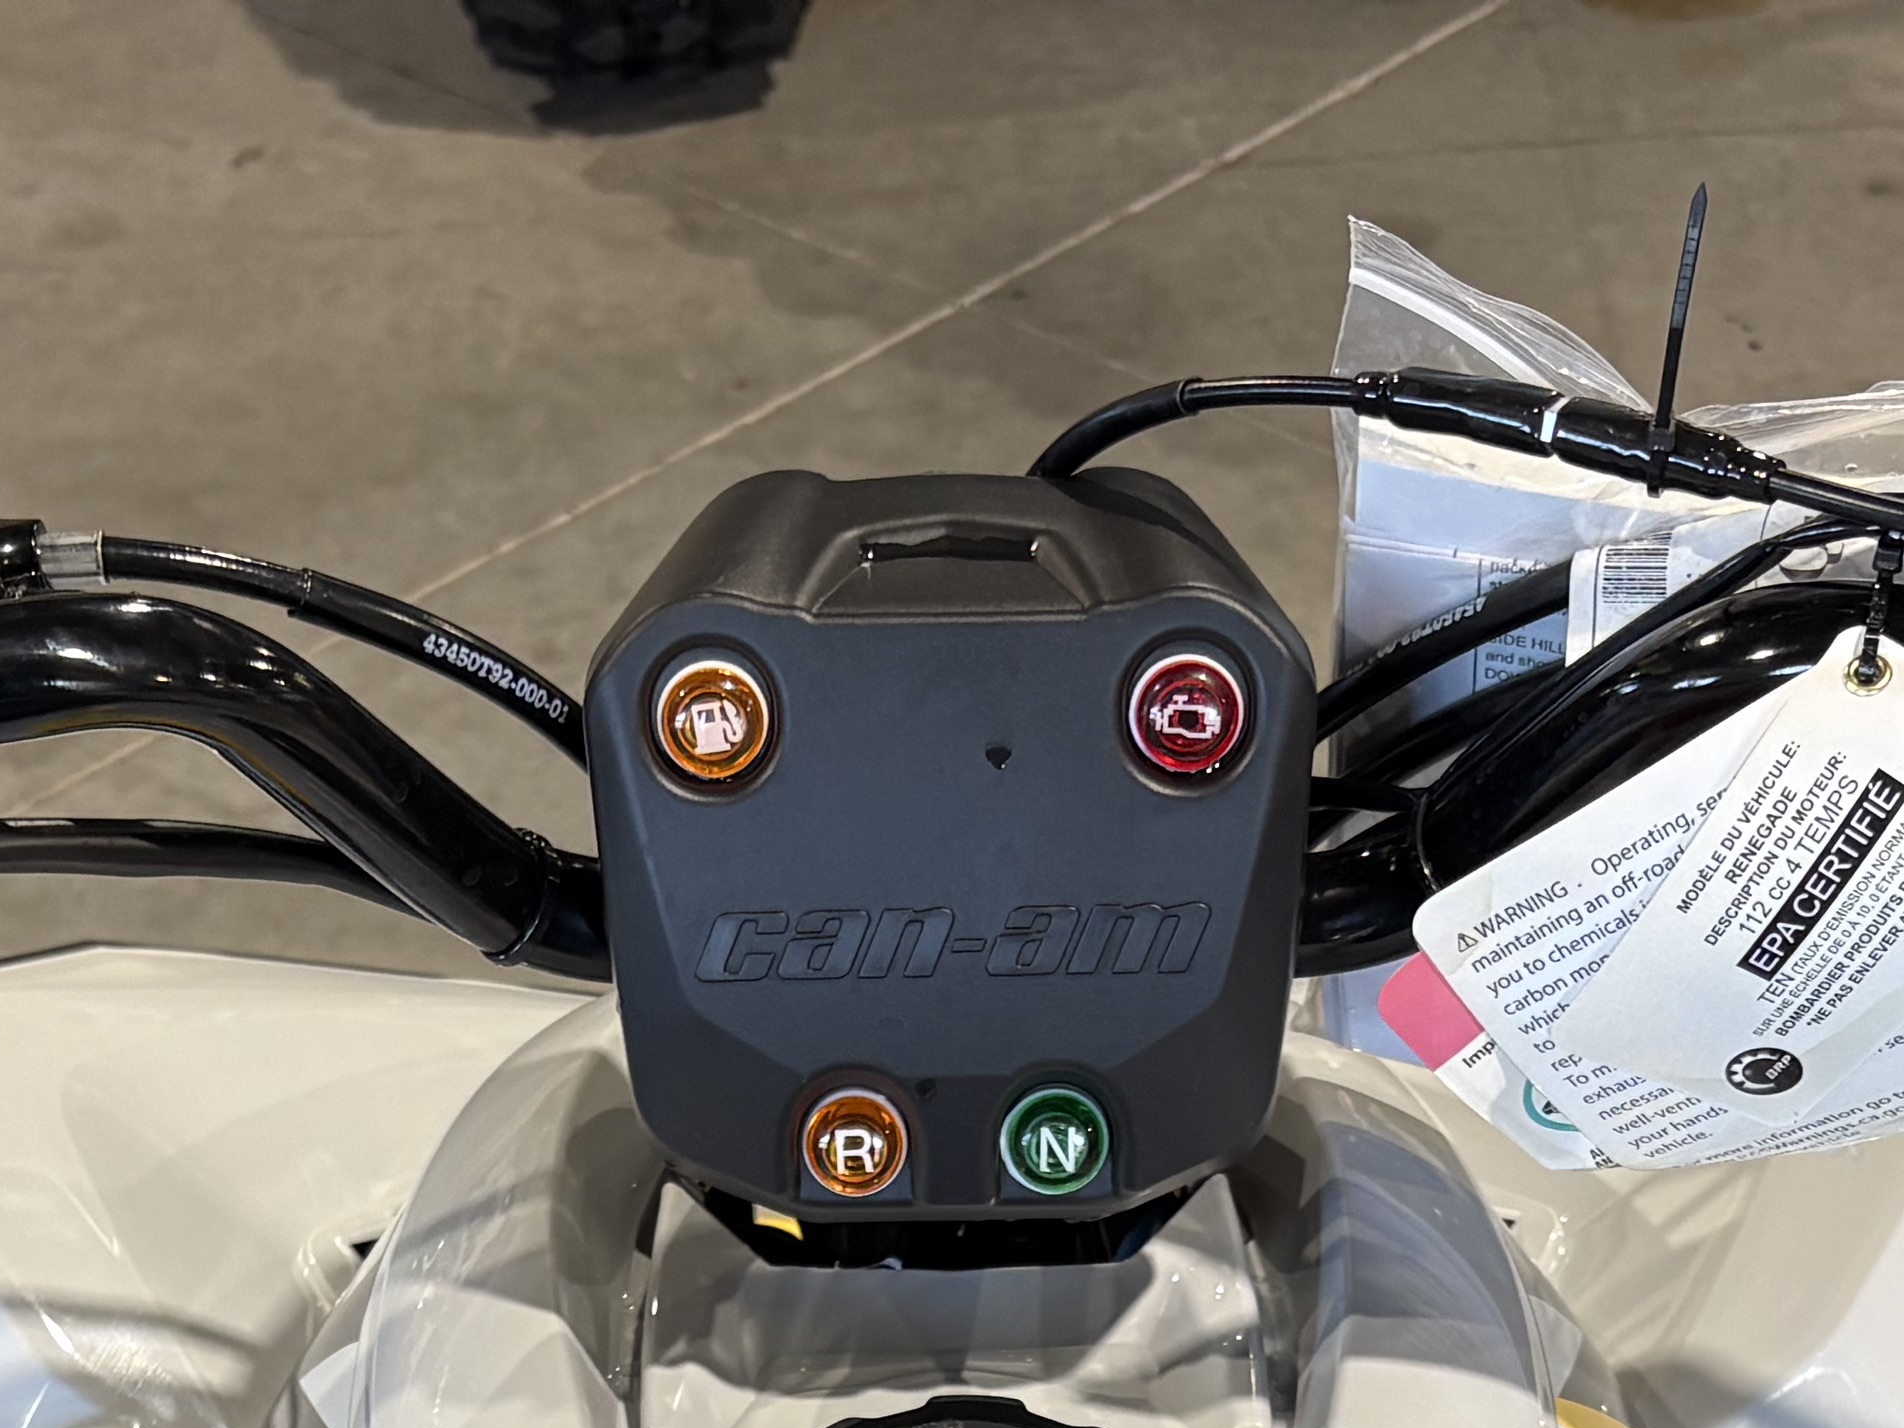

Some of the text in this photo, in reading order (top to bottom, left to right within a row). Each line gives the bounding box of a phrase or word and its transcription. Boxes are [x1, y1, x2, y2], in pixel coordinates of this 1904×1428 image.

[1490, 634, 1527, 648] IDE
[1675, 849, 1726, 914] MODÈLE
[1719, 825, 1743, 851] DU
[1736, 739, 1801, 824] VÉHICULE:
[1703, 849, 1779, 946] DESCRIPTION
[1772, 824, 1796, 851] DU
[1789, 750, 1846, 825] MOTEUR:
[1723, 785, 1797, 885] RENEGADE
[1738, 773, 1859, 934] 112 cc 4 TEMPS
[1474, 811, 1696, 939] WARNING Operating,
[1747, 779, 1901, 972] EPA CERTIFIÉ
[694, 901, 1212, 984] can-am
[1470, 906, 1584, 974] maintaining
[1582, 892, 1610, 914] an
[1485, 968, 1524, 999] you
[1522, 957, 1546, 975] to
[1547, 907, 1640, 963] chemicals
[1756, 970, 1795, 1004] TEN
[1789, 939, 1823, 975] (TAUX
[1774, 960, 1850, 1037] BOMBARDIER
[1843, 893, 1904, 962] PRODUITS
[1827, 983, 1854, 1009] PAS
[1848, 924, 1904, 985] ENLEVER
[1502, 976, 1568, 1016] carbon
[1532, 1038, 1556, 1054] to
[1562, 1073, 1589, 1088] To
[1765, 1055, 1791, 1080] BRP
[834, 1126, 882, 1177] R
[1040, 1124, 1077, 1174] N
[1627, 1105, 1728, 1151] your hands
[1753, 1106, 1864, 1150] information
[1865, 1096, 1892, 1110] go
